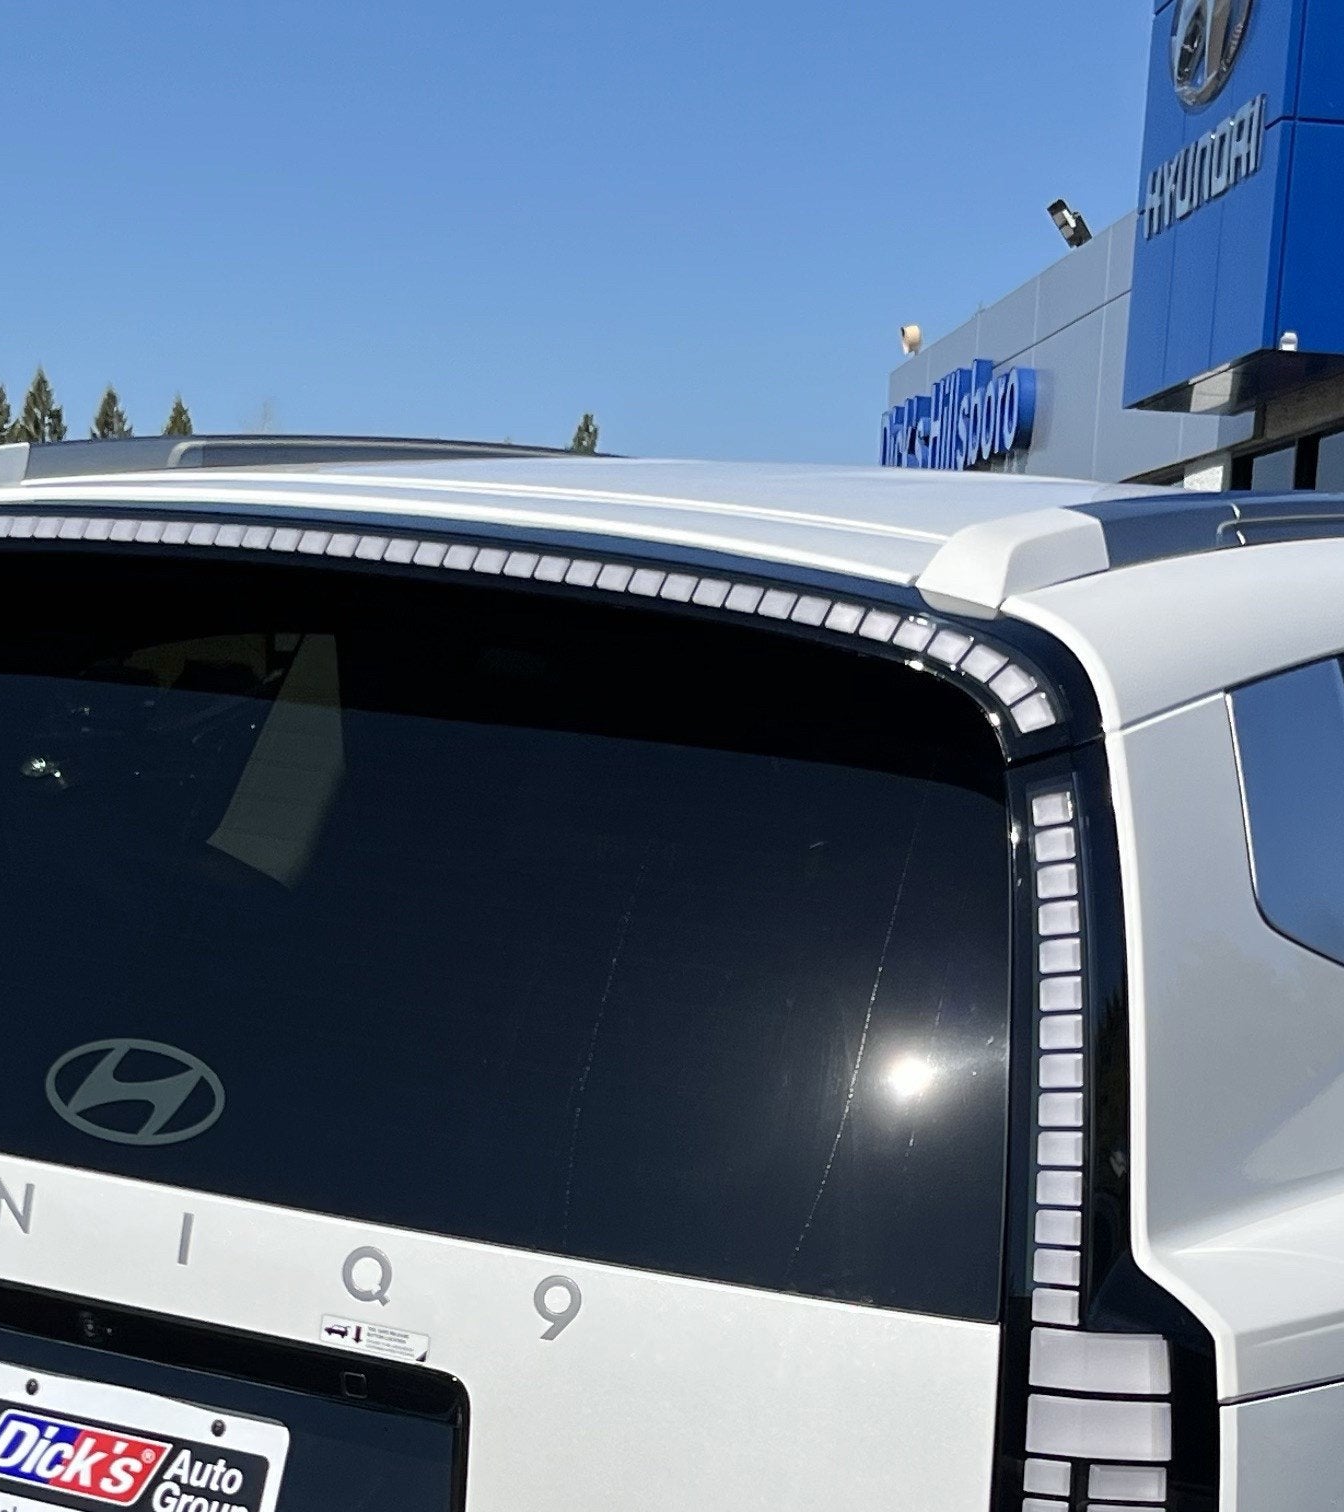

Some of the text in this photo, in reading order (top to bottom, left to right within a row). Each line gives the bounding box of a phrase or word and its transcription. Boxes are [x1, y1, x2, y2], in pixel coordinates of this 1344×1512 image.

[1144, 93, 1267, 240] HYUNDAI
[930, 359, 1036, 470] Hillsboro
[532, 1274, 583, 1342] 9
[163, 1448, 244, 1496] Auto
